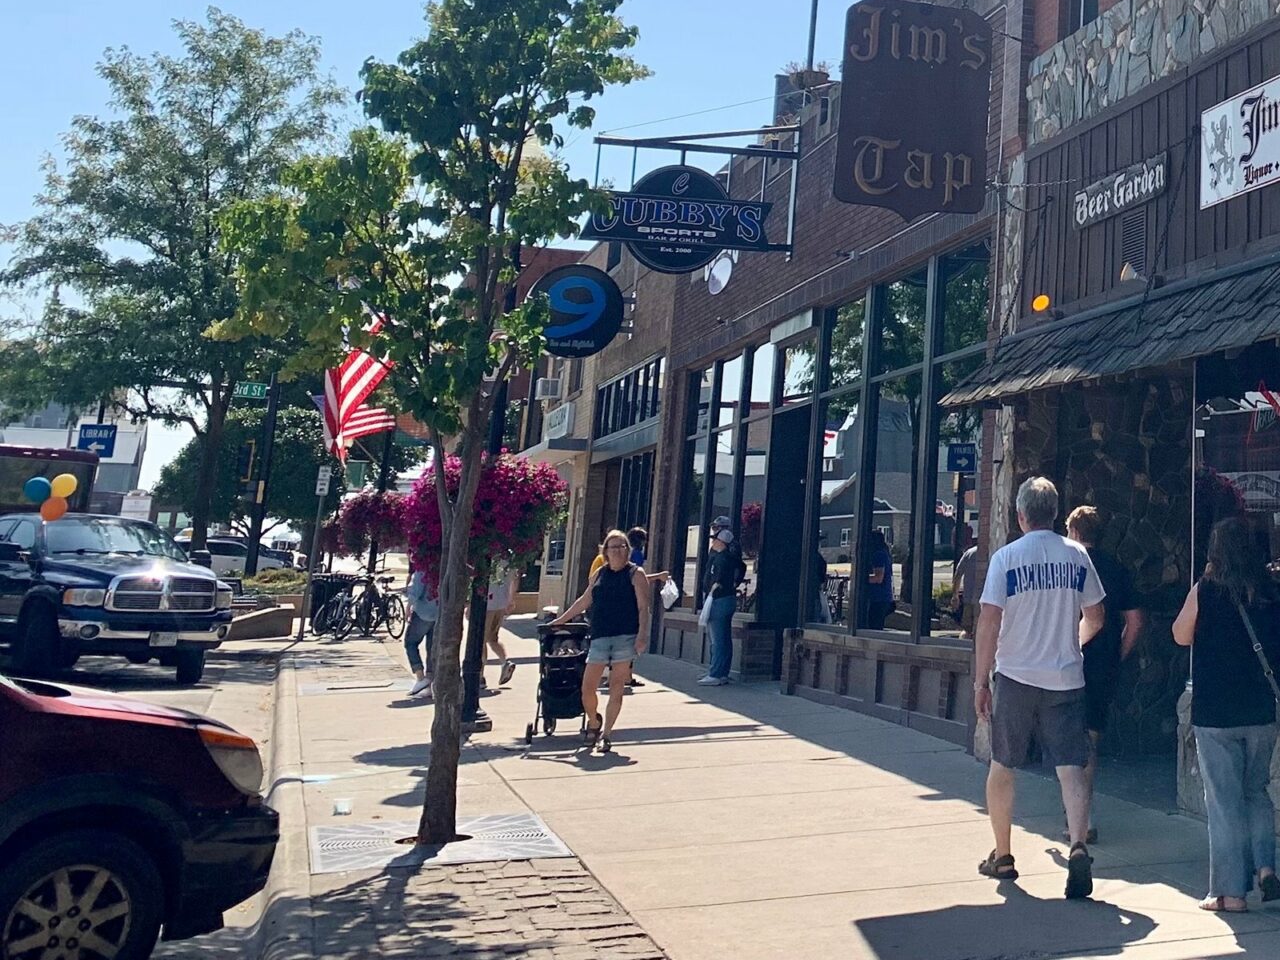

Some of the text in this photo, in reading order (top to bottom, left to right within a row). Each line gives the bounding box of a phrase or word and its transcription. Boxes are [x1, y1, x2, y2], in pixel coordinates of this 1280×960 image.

[850, 4, 988, 71] Jim's
[853, 135, 973, 207] Tap
[1075, 162, 1164, 225] Beer Garden
[1242, 162, 1273, 187] Liquor
[592, 197, 762, 243] CUBBY'S
[637, 226, 717, 238] SPORTS
[544, 275, 607, 339] 9
[233, 382, 262, 397] 3rd St
[81, 428, 115, 439] LIBRARY
